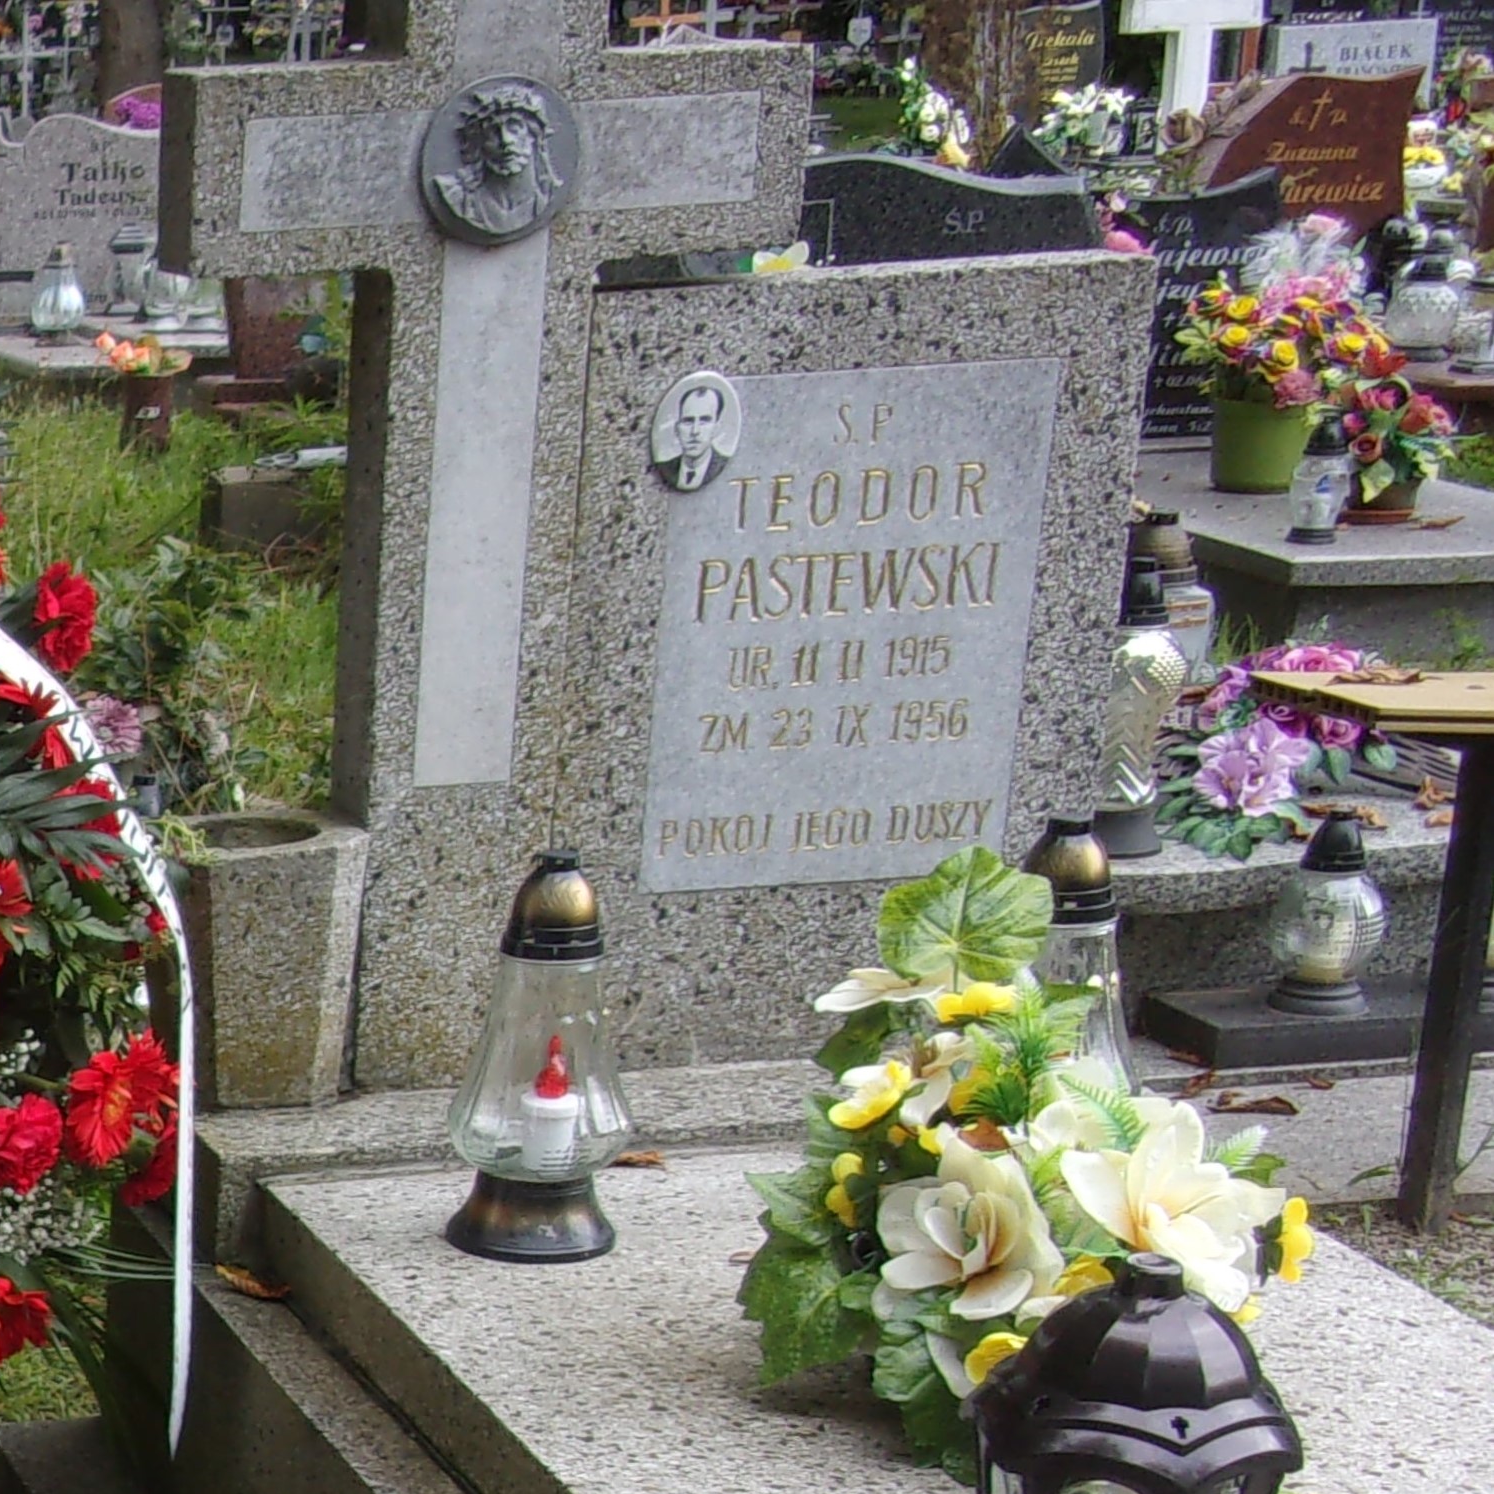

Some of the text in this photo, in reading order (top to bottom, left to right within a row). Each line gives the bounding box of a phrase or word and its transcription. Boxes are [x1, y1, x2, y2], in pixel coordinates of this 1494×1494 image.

[1265, 141, 1358, 162] Zuzanna
[1282, 172, 1384, 204] urewicz
[728, 461, 988, 533] TEODOR
[692, 541, 1002, 624] PASTEWSKI
[727, 644, 779, 692] UR.
[882, 635, 953, 681] 1915
[697, 697, 969, 754] ZM 23 IX 1956
[790, 806, 872, 852] JEGO
[886, 799, 994, 845] DUSZY
